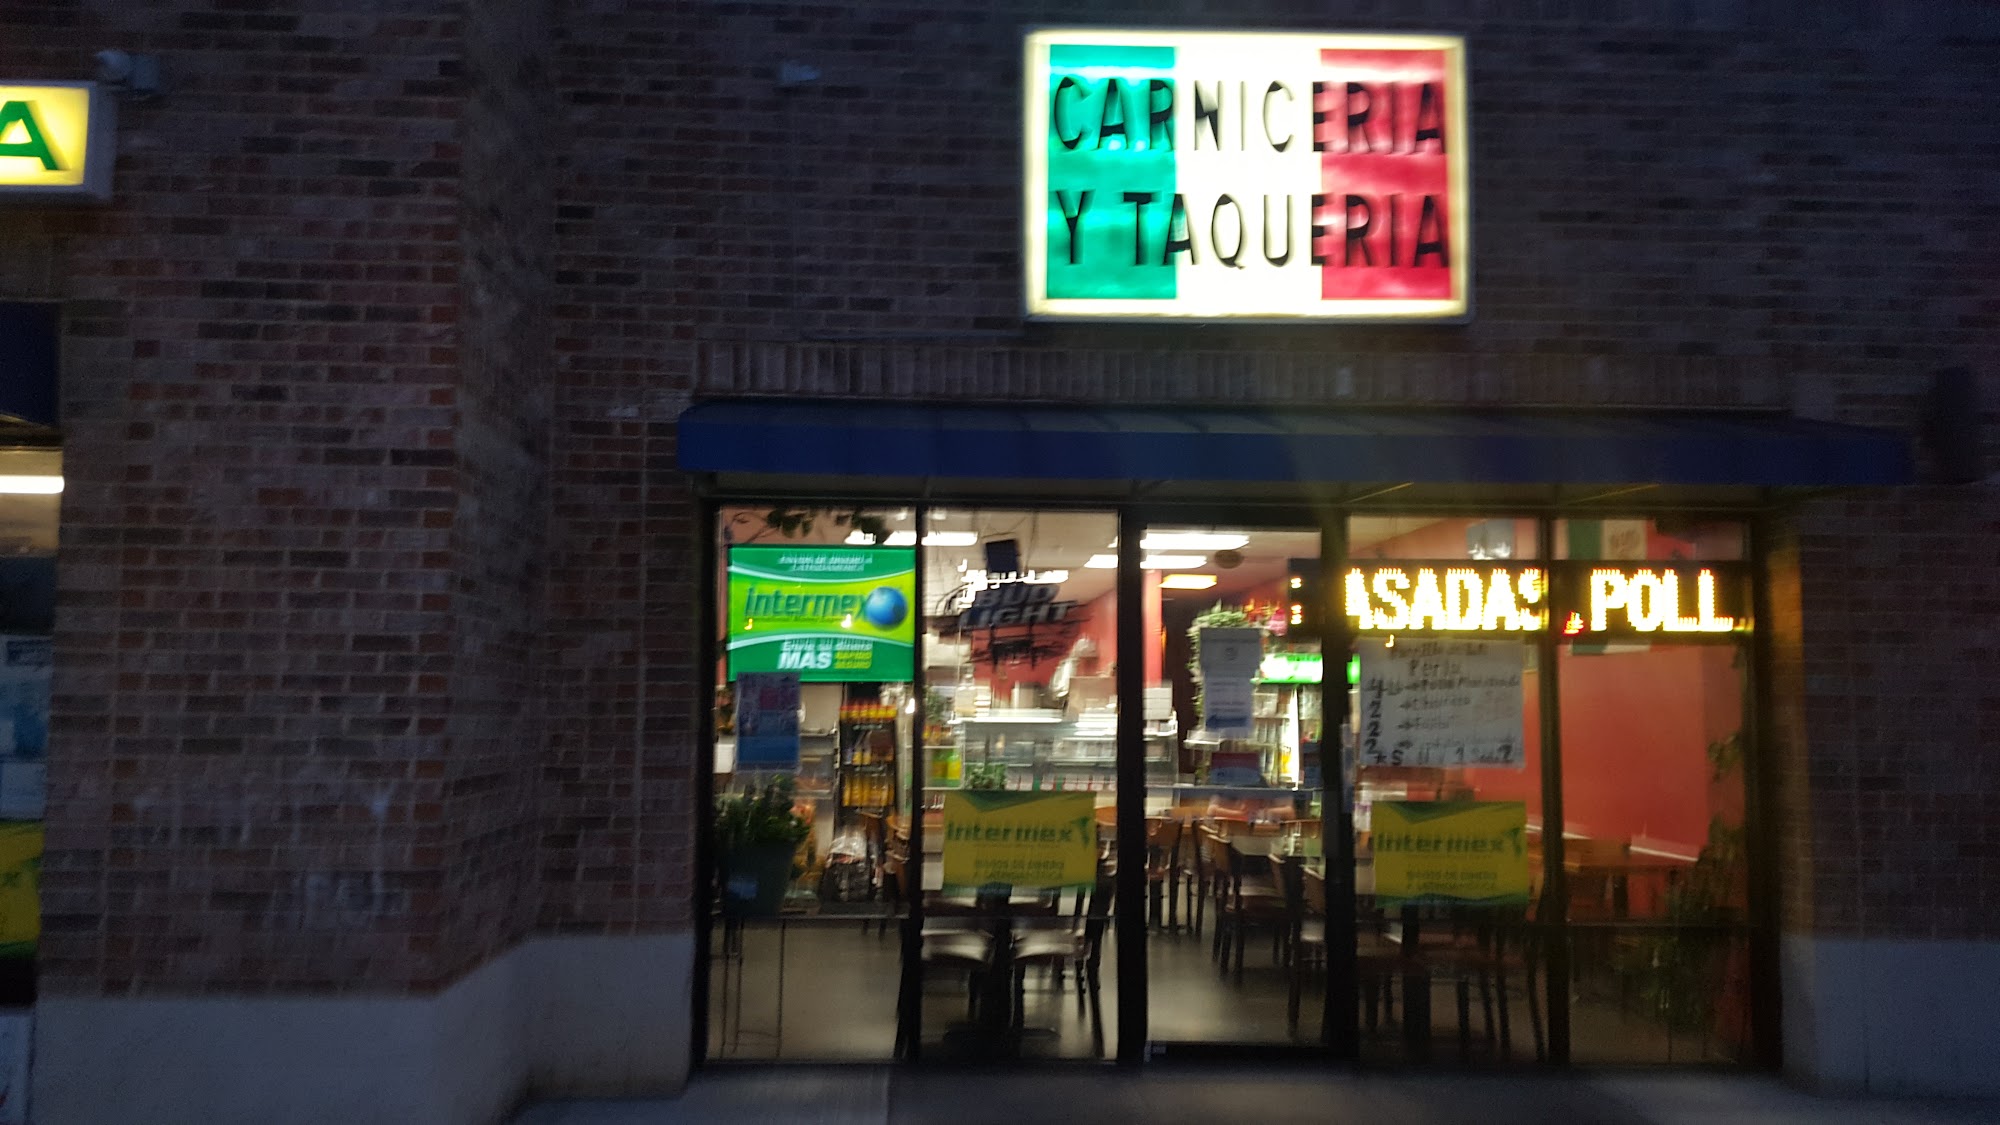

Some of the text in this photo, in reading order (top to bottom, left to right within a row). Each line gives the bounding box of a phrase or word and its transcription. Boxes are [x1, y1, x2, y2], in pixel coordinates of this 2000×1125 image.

[1054, 76, 1445, 154] CARNICERIA
[1056, 189, 1449, 269] Y TAQUERIA
[744, 585, 869, 619] intermex
